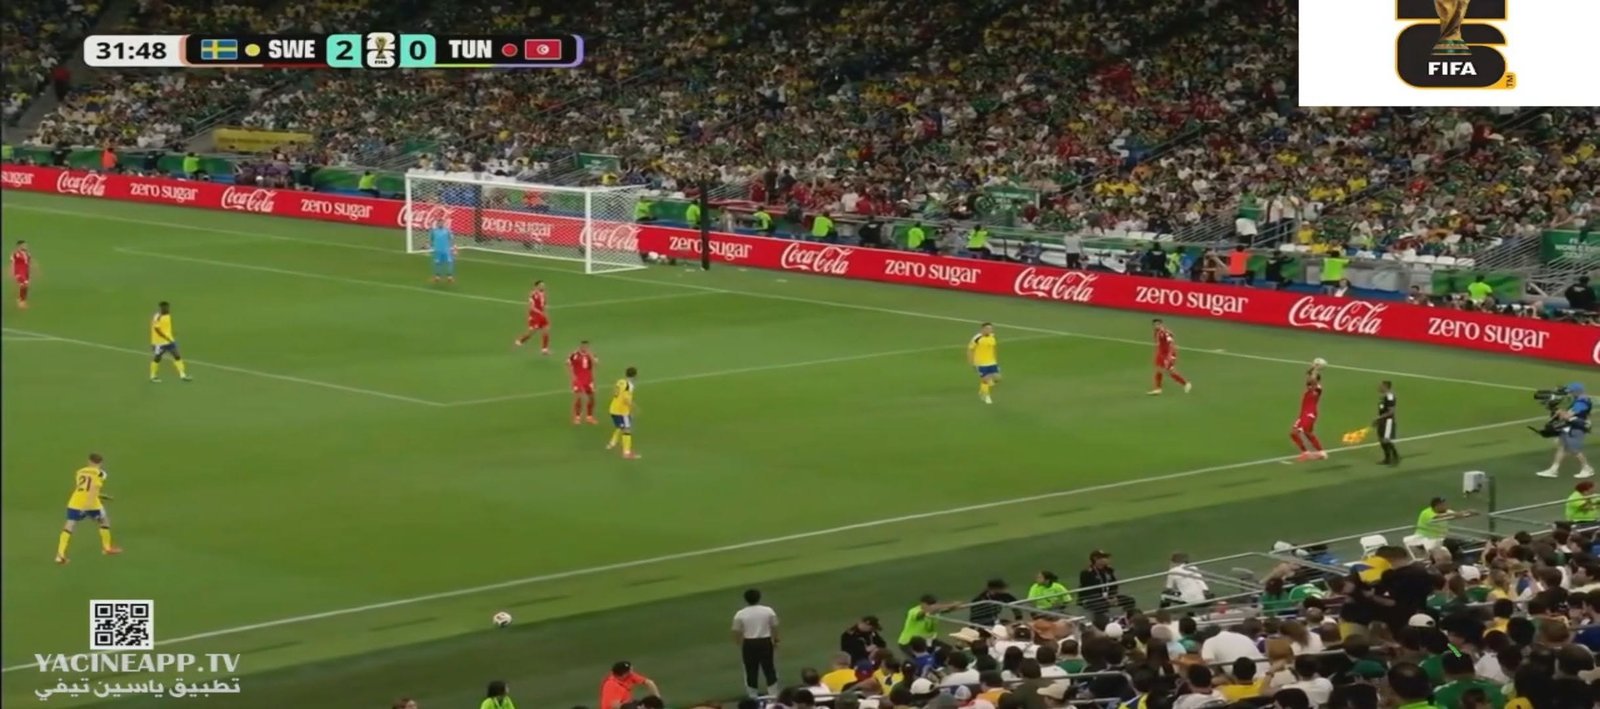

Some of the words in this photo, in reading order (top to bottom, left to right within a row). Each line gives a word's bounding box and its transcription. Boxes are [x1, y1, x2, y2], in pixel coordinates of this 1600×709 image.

[1, 171, 35, 188] sugar
[130, 182, 160, 198] zero
[161, 184, 199, 203] sugar
[301, 198, 332, 214] zero
[334, 203, 374, 221] sugar
[579, 222, 642, 252] Cca-Cola
[669, 235, 704, 253] zero
[708, 239, 752, 261] sugar
[781, 242, 854, 275] Coca-Cola
[884, 258, 926, 278] zero
[928, 264, 981, 286] sugar
[1014, 267, 1099, 302] Coca-Cola
[1135, 285, 1183, 306] zero
[1186, 290, 1249, 316] sugar
[1288, 296, 1389, 335] Coca-Cola
[1427, 316, 1480, 341] zero
[1483, 322, 1550, 351] sugar
[78, 475, 92, 492] 21
